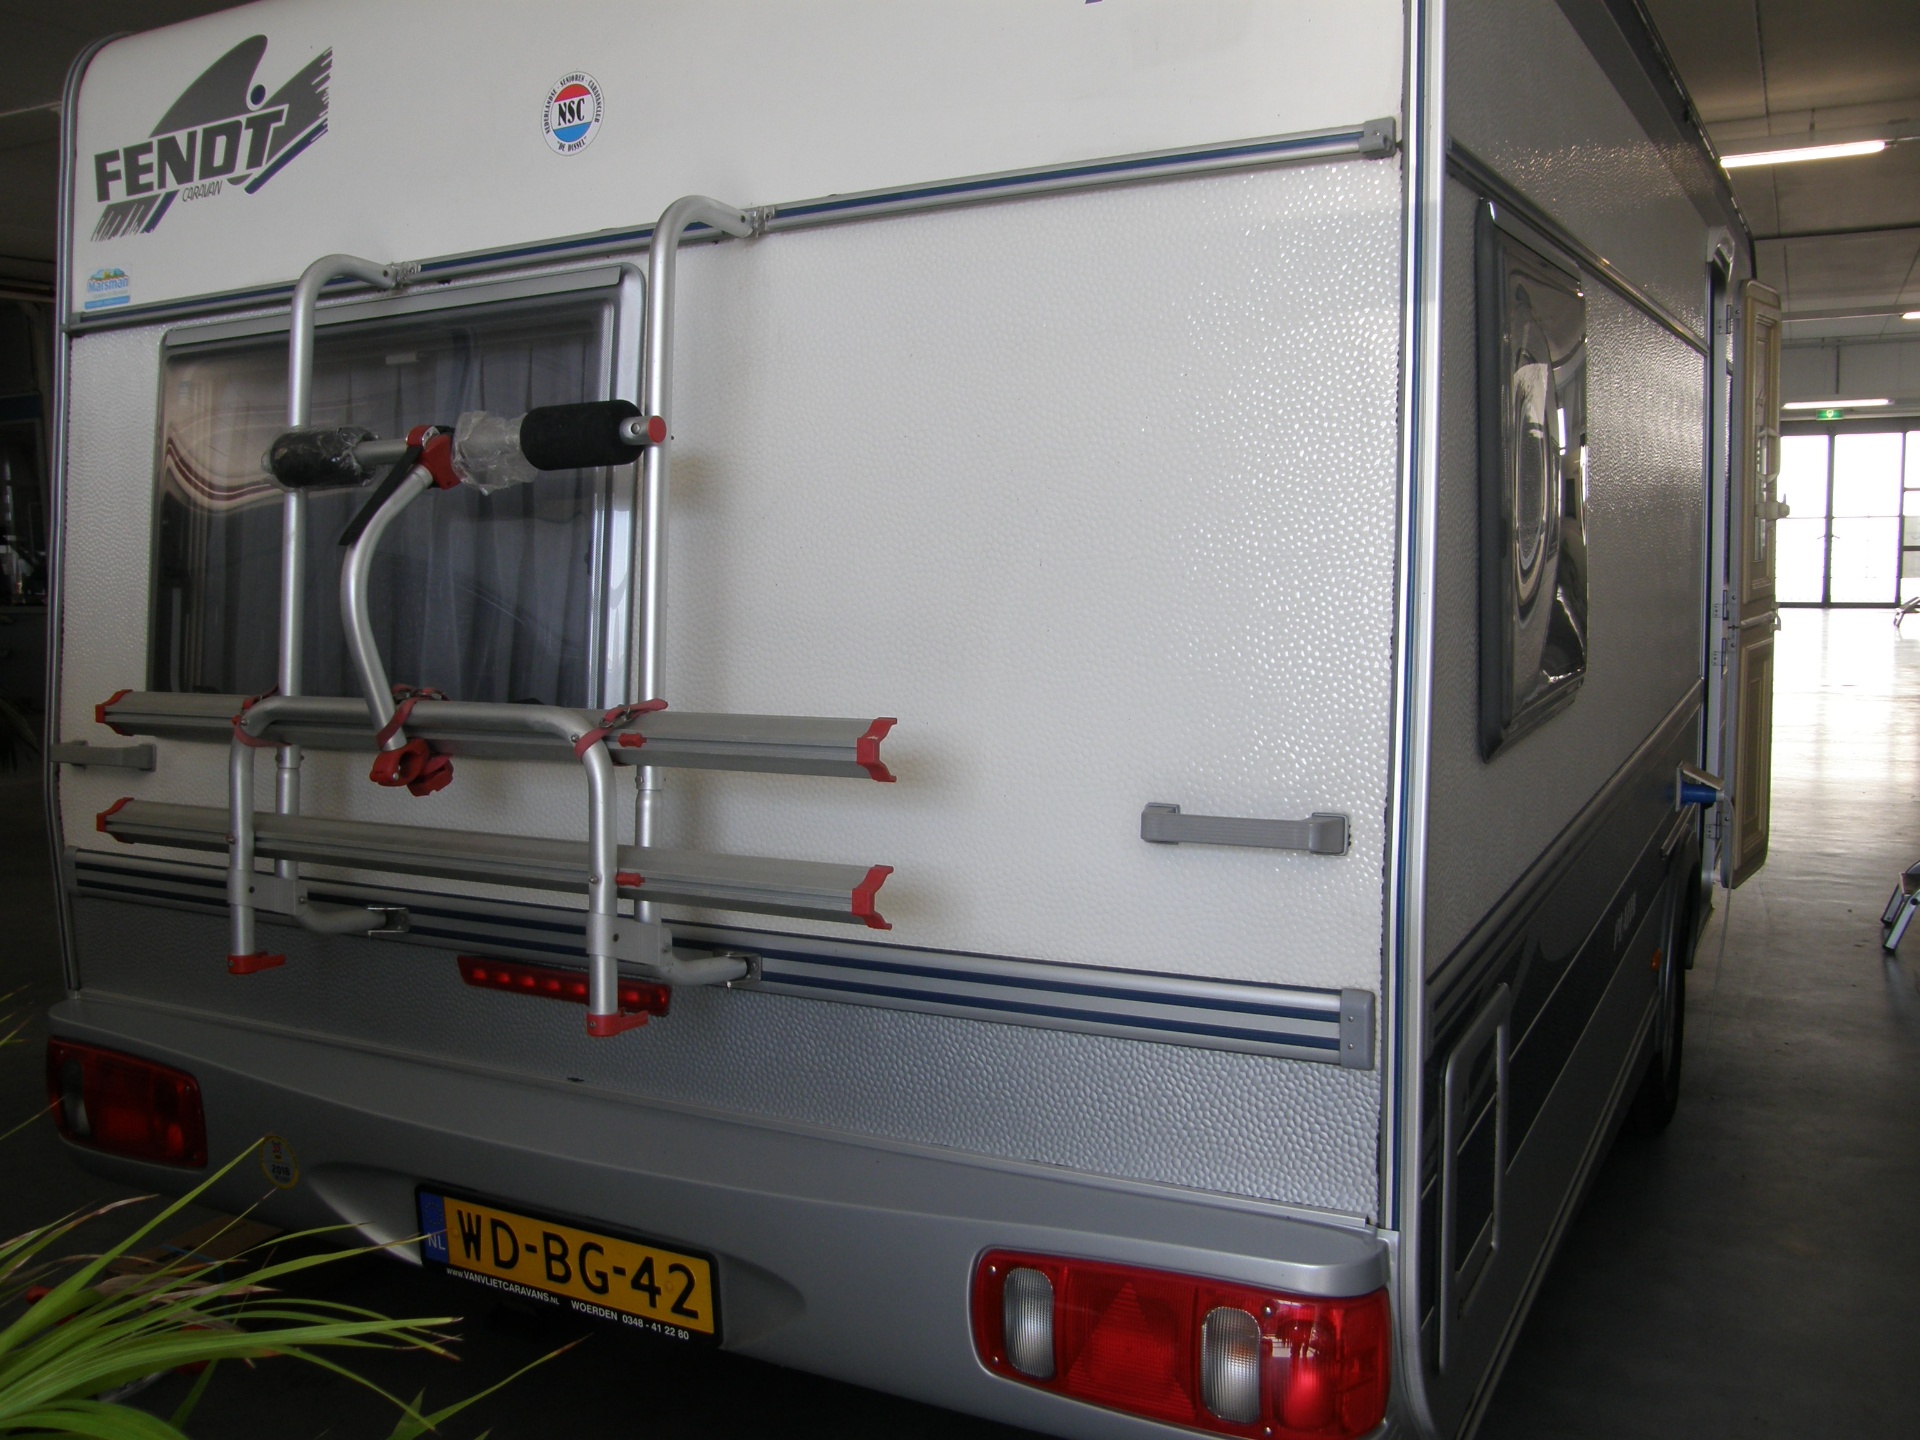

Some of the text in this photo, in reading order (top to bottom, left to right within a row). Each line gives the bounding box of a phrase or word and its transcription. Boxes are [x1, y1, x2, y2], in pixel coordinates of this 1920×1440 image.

[558, 98, 585, 126] NSC
[94, 108, 285, 202] FENDT
[182, 180, 223, 203] CARAVAN
[87, 278, 129, 292] Marsman
[428, 1233, 446, 1251] NL
[457, 1209, 699, 1318] WD-BG-42
[571, 1300, 618, 1321] WOERDEN
[622, 1314, 644, 1329] 0348
[651, 1322, 662, 1333] 41
[664, 1326, 676, 1337] 22
[678, 1329, 690, 1340] 80
